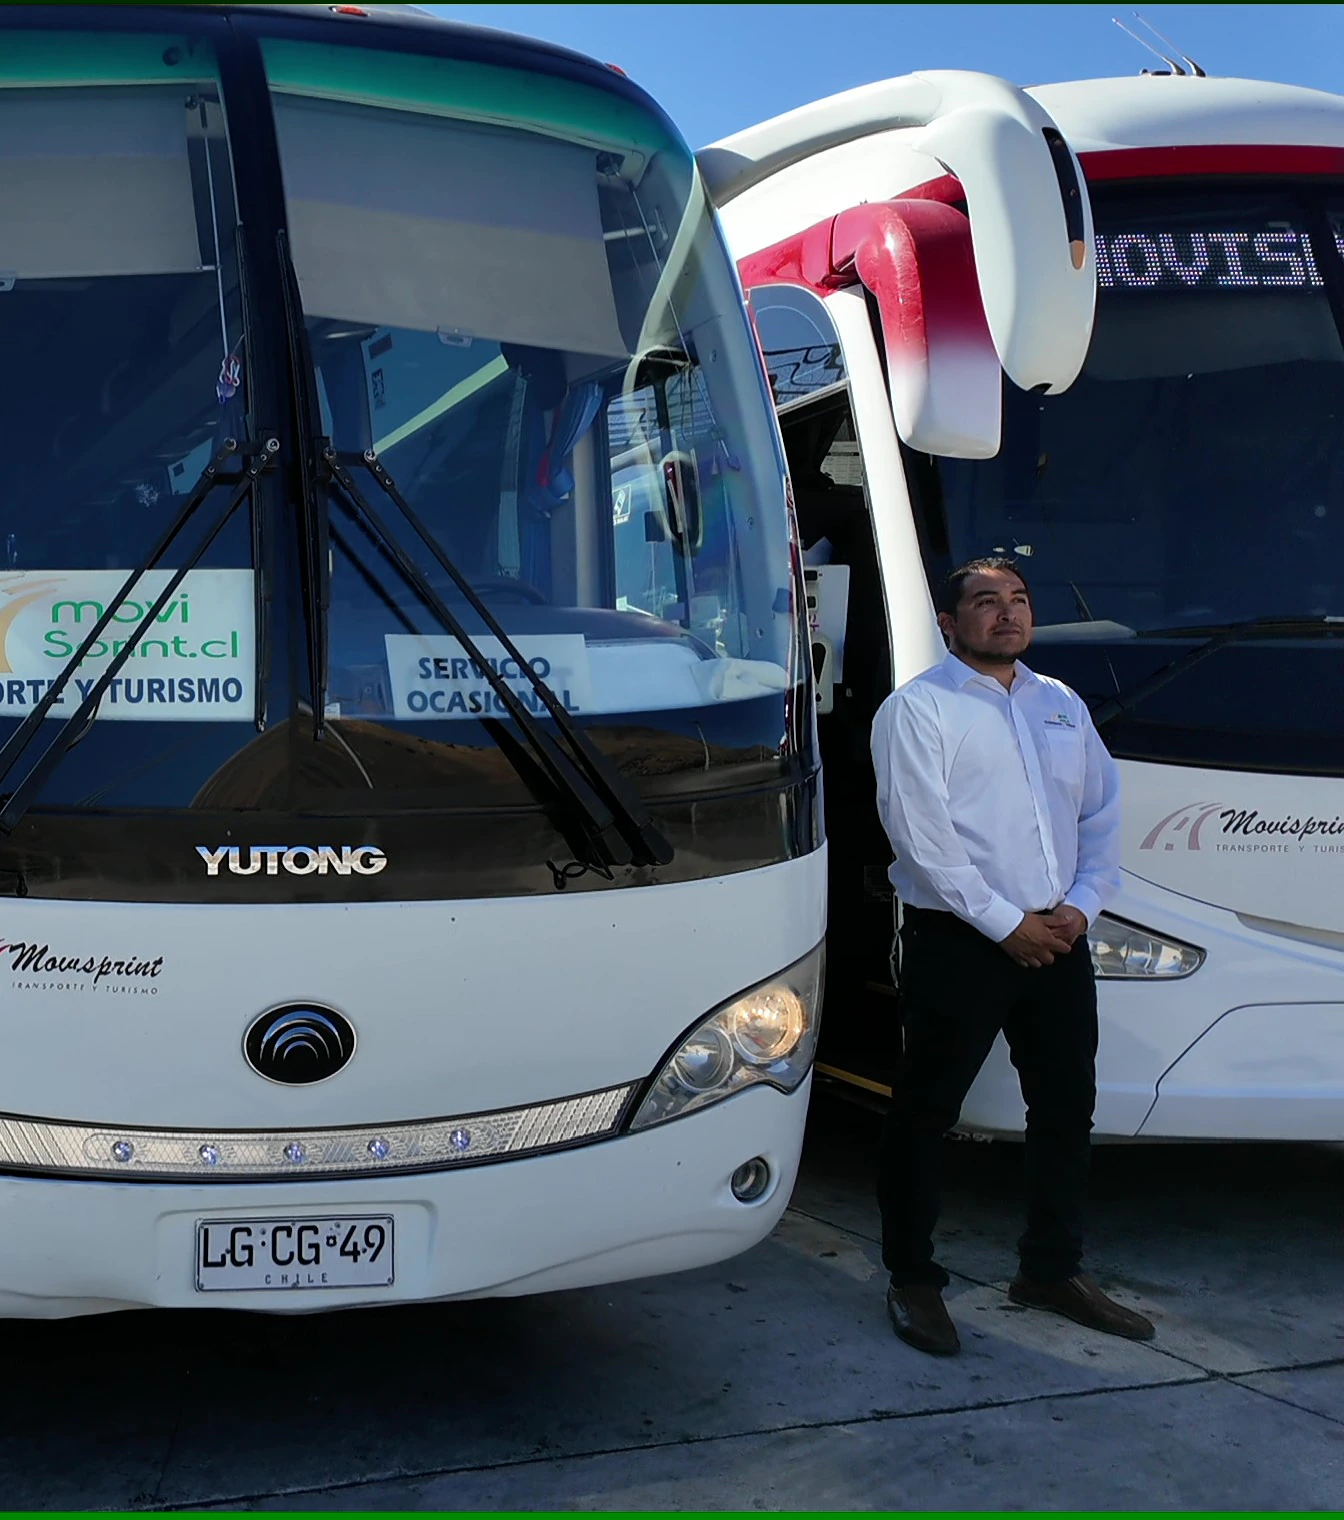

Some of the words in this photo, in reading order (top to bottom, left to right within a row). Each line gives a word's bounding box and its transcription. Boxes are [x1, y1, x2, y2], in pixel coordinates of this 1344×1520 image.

[51, 593, 189, 623] movi
[43, 630, 239, 668] Sprnt.cl
[74, 679, 95, 703] Y
[108, 677, 243, 704] TURISMO
[406, 689, 580, 714] OCASINL
[194, 845, 388, 876] YUTONG
[1216, 843, 1289, 853] TRANSPORTE
[106, 985, 158, 995] TURISMO
